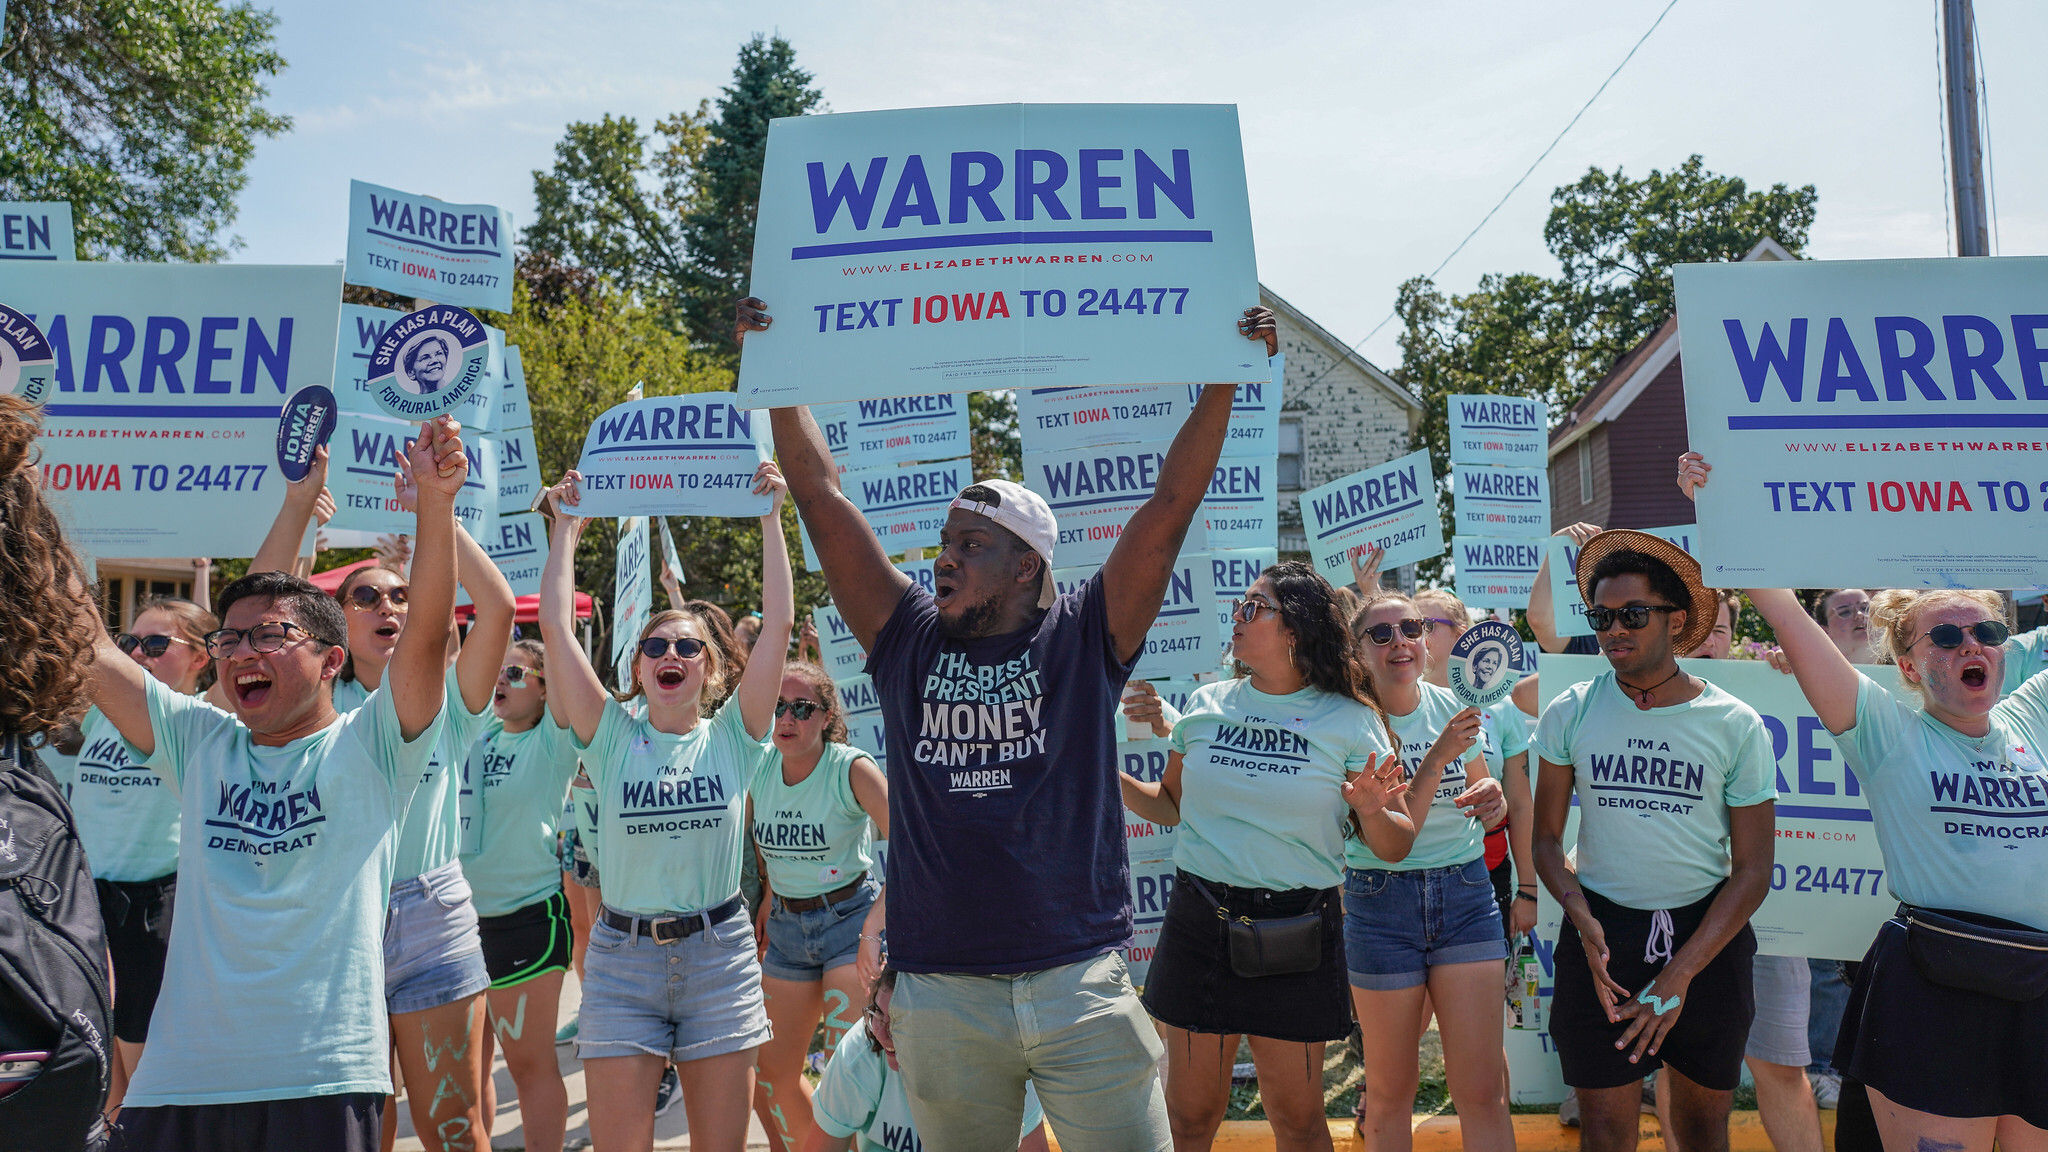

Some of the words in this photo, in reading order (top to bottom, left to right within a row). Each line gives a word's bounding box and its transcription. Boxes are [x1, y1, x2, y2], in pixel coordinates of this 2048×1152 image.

[806, 148, 1195, 234] WARREN
[370, 194, 498, 248] WARREN
[367, 252, 399, 272] TEXT
[402, 261, 437, 281] IOWA
[440, 270, 457, 285] TO
[459, 273, 499, 289] 24477
[842, 253, 1154, 277] WWW.ELIZABETHWARREN.COM
[814, 298, 904, 333] TEXT
[912, 291, 1010, 325] IOWA
[1019, 289, 1067, 317] TO
[1077, 287, 1190, 316] 24477
[376, 337, 399, 366] SHE
[397, 310, 425, 339] HAS
[428, 310, 439, 325] A
[440, 311, 477, 338] PLAN
[25, 314, 294, 394] ARREN
[379, 385, 401, 407] FOR
[398, 398, 440, 414] RURAL
[442, 356, 483, 407] AMERICA
[598, 403, 751, 445] WARREN
[1036, 412, 1070, 429] TEXT
[1073, 407, 1111, 425] IOWA
[1112, 406, 1129, 420] TO
[1132, 401, 1173, 419] 24477
[1460, 402, 1535, 425] WARREN
[284, 403, 312, 462] IOWA
[298, 405, 323, 464] WARREN
[860, 439, 884, 452] TEXT
[886, 435, 911, 448] IOWA
[913, 434, 926, 444] TO
[927, 430, 957, 443] 24477
[1231, 428, 1264, 439] 24477
[1463, 440, 1482, 451] TEXT
[1483, 441, 1504, 451] IOWA
[1505, 442, 1513, 452] TO
[1514, 443, 1539, 453] 24477
[1785, 442, 2048, 453] WWW.ELIZABETHWARRE
[42, 463, 122, 491] IOWA
[131, 464, 169, 491] TO
[175, 464, 268, 491] 24477
[585, 474, 626, 490] TEXT
[630, 473, 674, 490] IOWA
[678, 473, 699, 489] TO
[703, 473, 753, 489] 24477
[862, 469, 958, 506] WARREN
[1465, 472, 1539, 497] WARREN
[346, 494, 382, 510] TEXT
[1311, 465, 1418, 529] WARREN
[1763, 481, 1856, 512] TEXT
[1867, 481, 1973, 512] IOWA
[1977, 481, 2030, 512] TO
[890, 520, 916, 535] IOWA
[918, 519, 931, 531] TO
[1214, 519, 1228, 531] TO
[1230, 518, 1263, 530] 24477
[1466, 512, 1485, 522] TEXT
[1486, 513, 1506, 523] IOWA
[1507, 514, 1517, 524] TO
[1518, 514, 1542, 524] 24477
[1324, 551, 1345, 570] TEXT
[1393, 524, 1426, 546] 24477
[1464, 544, 1539, 567] WARREN
[1467, 585, 1486, 595] TEXT
[1487, 585, 1508, 595] IOWA
[1509, 585, 1518, 595] TO
[1160, 635, 1202, 653] 24477
[1460, 630, 1480, 651] SHE
[1481, 626, 1501, 638] HAS
[1500, 629, 1509, 640] A
[1506, 634, 1521, 662] PLAN
[835, 652, 857, 666] TEXT
[935, 652, 977, 680] THE
[977, 648, 1031, 692] BEST
[923, 669, 1042, 706] PRESIDENT
[1452, 667, 1461, 685] FOR
[1455, 684, 1478, 704] RURAL
[1479, 678, 1513, 704] AMERICA
[919, 696, 1044, 740] MONEY
[914, 739, 993, 767] CAN'T
[999, 728, 1047, 762] BUY
[1215, 724, 1309, 756] WARREN
[1403, 742, 1422, 753] I'M
[1424, 741, 1433, 750] A
[1627, 738, 1654, 750] I'M
[1657, 741, 1671, 752] A
[656, 765, 677, 776] I'M
[681, 765, 693, 775] A
[1209, 755, 1301, 775] DEMOCRAT
[1590, 753, 1704, 793] WARREN
[80, 773, 162, 787] DEMOCRAT
[252, 780, 276, 794] I'M
[281, 780, 291, 793] A
[950, 768, 1011, 788] WARREN
[623, 774, 725, 809] WARREN
[218, 780, 321, 831] WARREN
[775, 810, 793, 819] I'M
[794, 810, 803, 819] A
[1597, 796, 1694, 816] DEMOCRAT
[626, 817, 722, 835] DEMOCRAT
[753, 818, 826, 846] WARREN
[207, 832, 317, 856] DEMOCRAT
[1794, 865, 1884, 896] 24477
